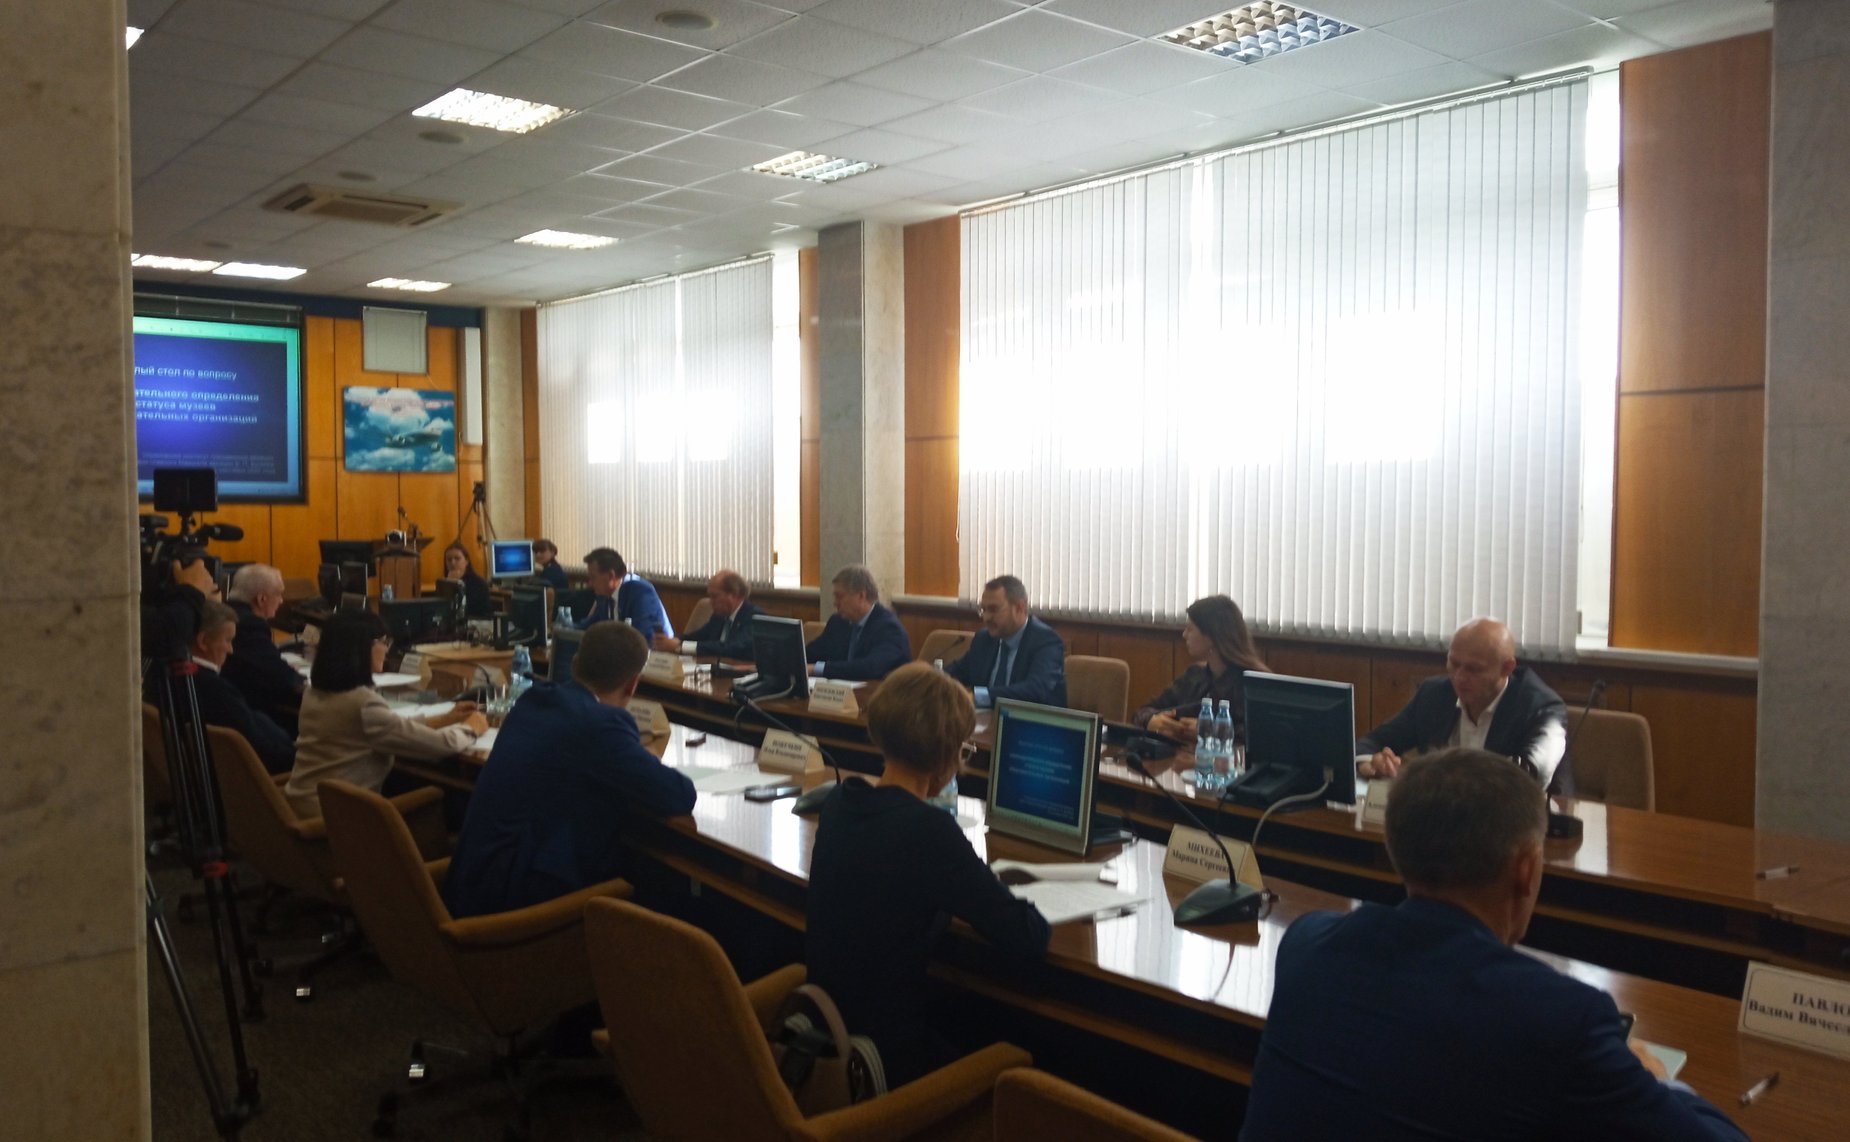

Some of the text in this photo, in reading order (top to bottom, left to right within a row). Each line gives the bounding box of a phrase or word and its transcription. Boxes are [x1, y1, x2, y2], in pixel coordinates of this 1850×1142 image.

[157, 367, 180, 377] стол
[183, 368, 195, 378] по
[198, 369, 237, 381] вопросу
[191, 391, 260, 402] определения
[1749, 999, 1793, 1020] Вадим
